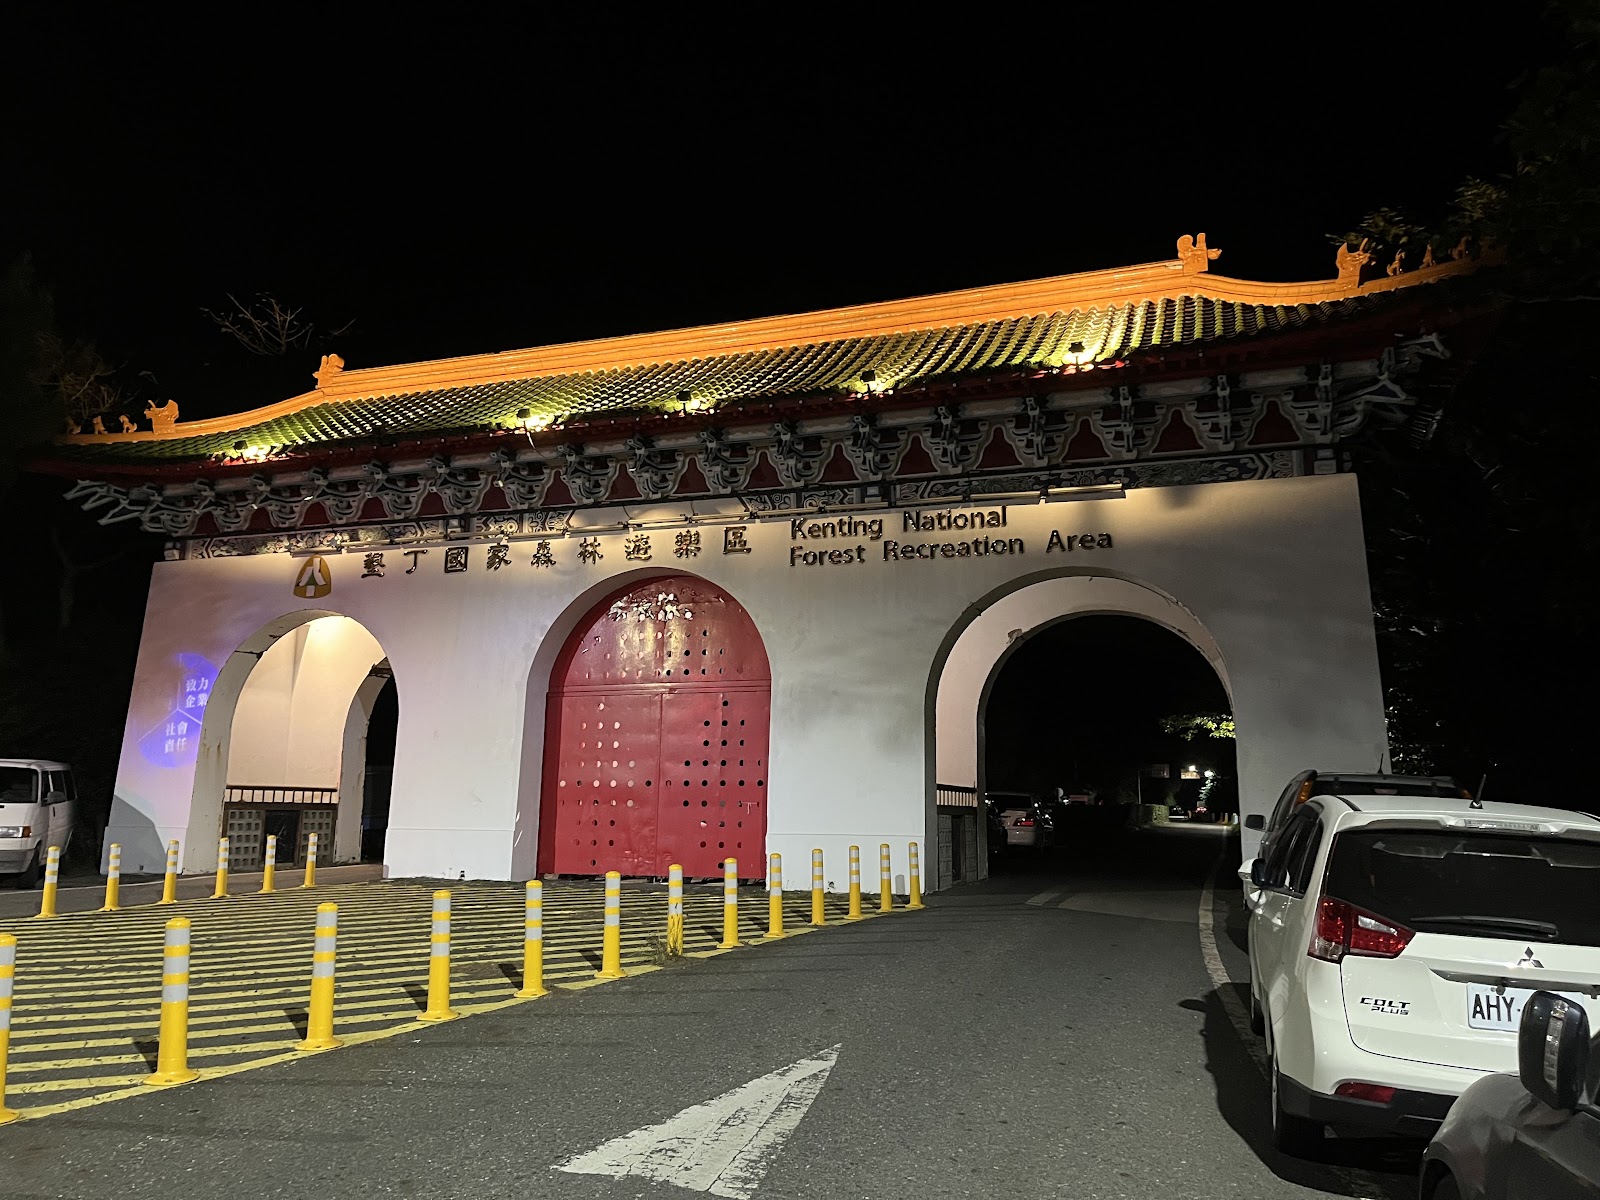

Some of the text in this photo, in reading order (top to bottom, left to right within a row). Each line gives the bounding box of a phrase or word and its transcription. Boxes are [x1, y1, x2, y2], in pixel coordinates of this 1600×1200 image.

[790, 505, 1008, 541] Kenting National
[361, 526, 752, 578] 墾丁國家森林遊樂區
[789, 529, 1113, 567] Forest Recreation Area
[1360, 997, 1411, 1009] COLT
[1371, 1005, 1410, 1016] PLUS
[1472, 993, 1521, 1022] AHY-
